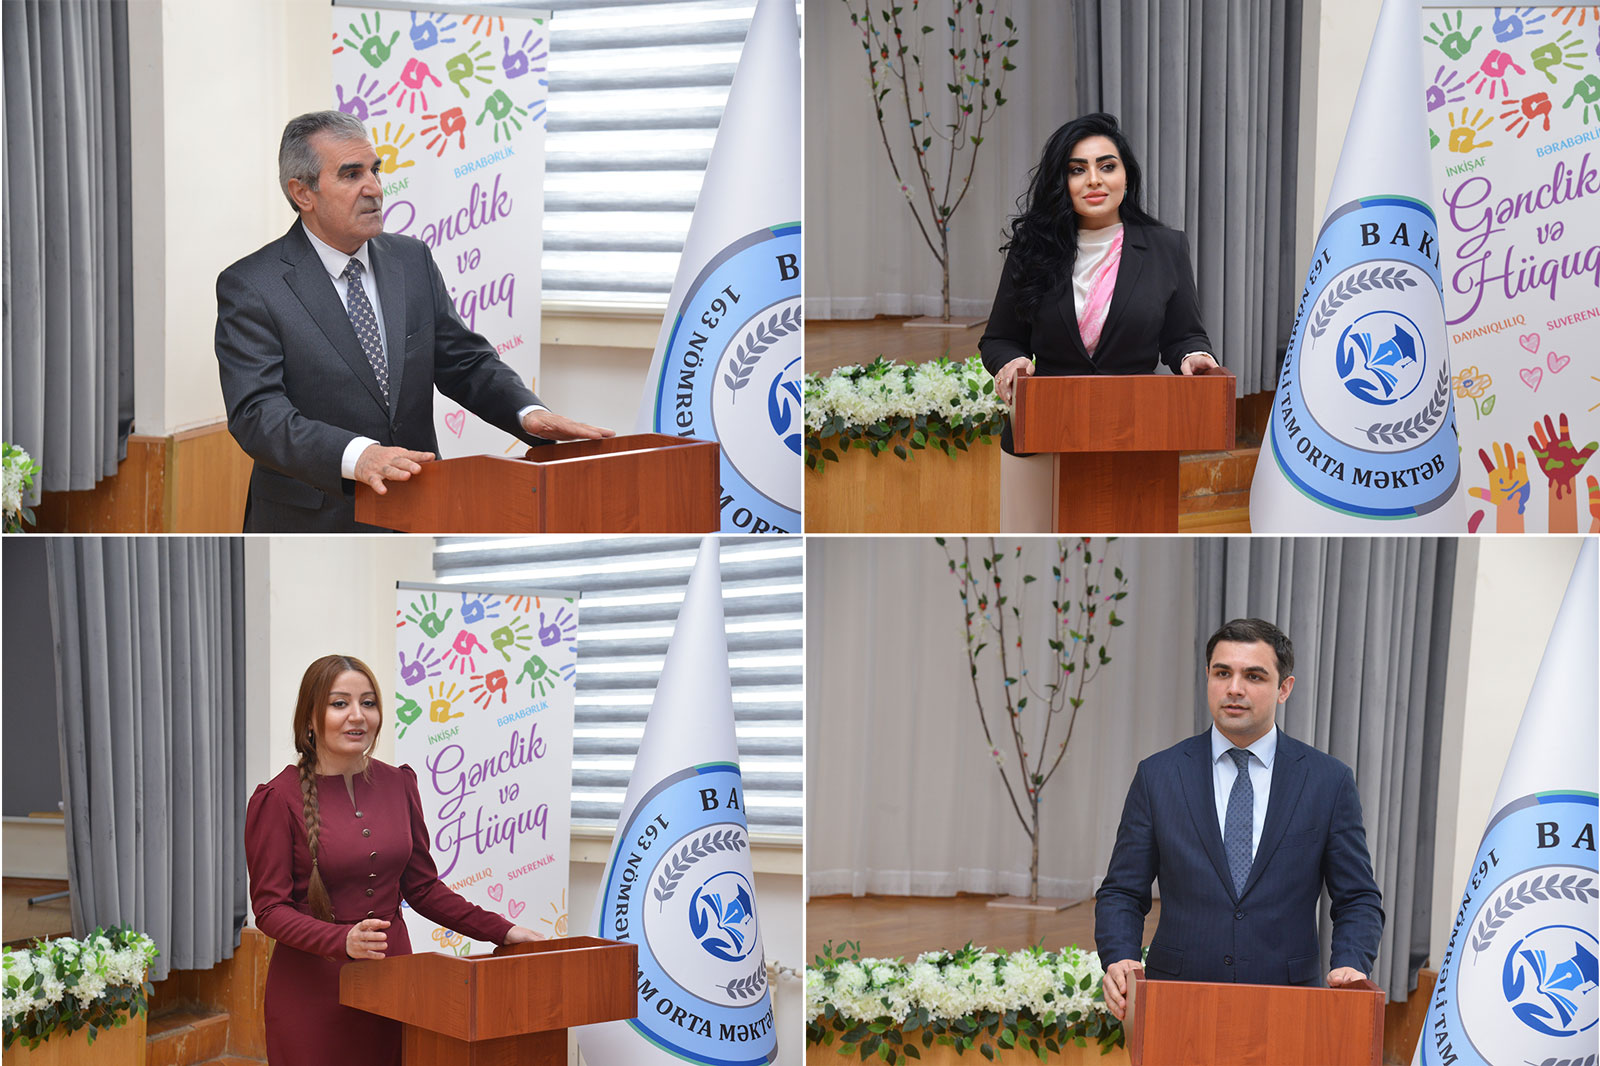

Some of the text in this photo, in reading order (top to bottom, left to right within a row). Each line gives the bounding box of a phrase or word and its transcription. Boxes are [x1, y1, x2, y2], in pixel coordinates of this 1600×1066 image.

[1536, 126, 1600, 158] BƏRABƏRLİ
[454, 145, 515, 179] BƏRABƏRLİK
[1446, 156, 1486, 177] İNKİŞAF
[383, 177, 410, 197] KİŞAF
[1443, 152, 1600, 259] Gənclik
[1536, 221, 1564, 245] və
[457, 248, 481, 274] və
[1309, 247, 1332, 286] 163
[701, 284, 741, 330] 163
[495, 334, 524, 355] ENLİK
[1452, 313, 1526, 345] DAYANIQLILIQ
[675, 330, 709, 437] NÖMRƏ
[1281, 392, 1301, 440] TAM
[1296, 436, 1345, 482] ORTA
[1351, 454, 1445, 489] MƏKTƏB
[496, 700, 549, 728] BƏRABƏRLİK
[427, 725, 460, 746] İNKİŞAF
[426, 722, 547, 820] Gənclik
[499, 782, 520, 805] və
[698, 787, 746, 816] BA
[435, 803, 549, 881] Hüquq
[637, 813, 670, 851] 163
[449, 867, 493, 891] ANIQLILIQ
[507, 853, 556, 881] SUVERENLİK
[1471, 848, 1500, 890] 163
[615, 851, 643, 941] NÖMRƏ
[656, 998, 713, 1039] ORTA
